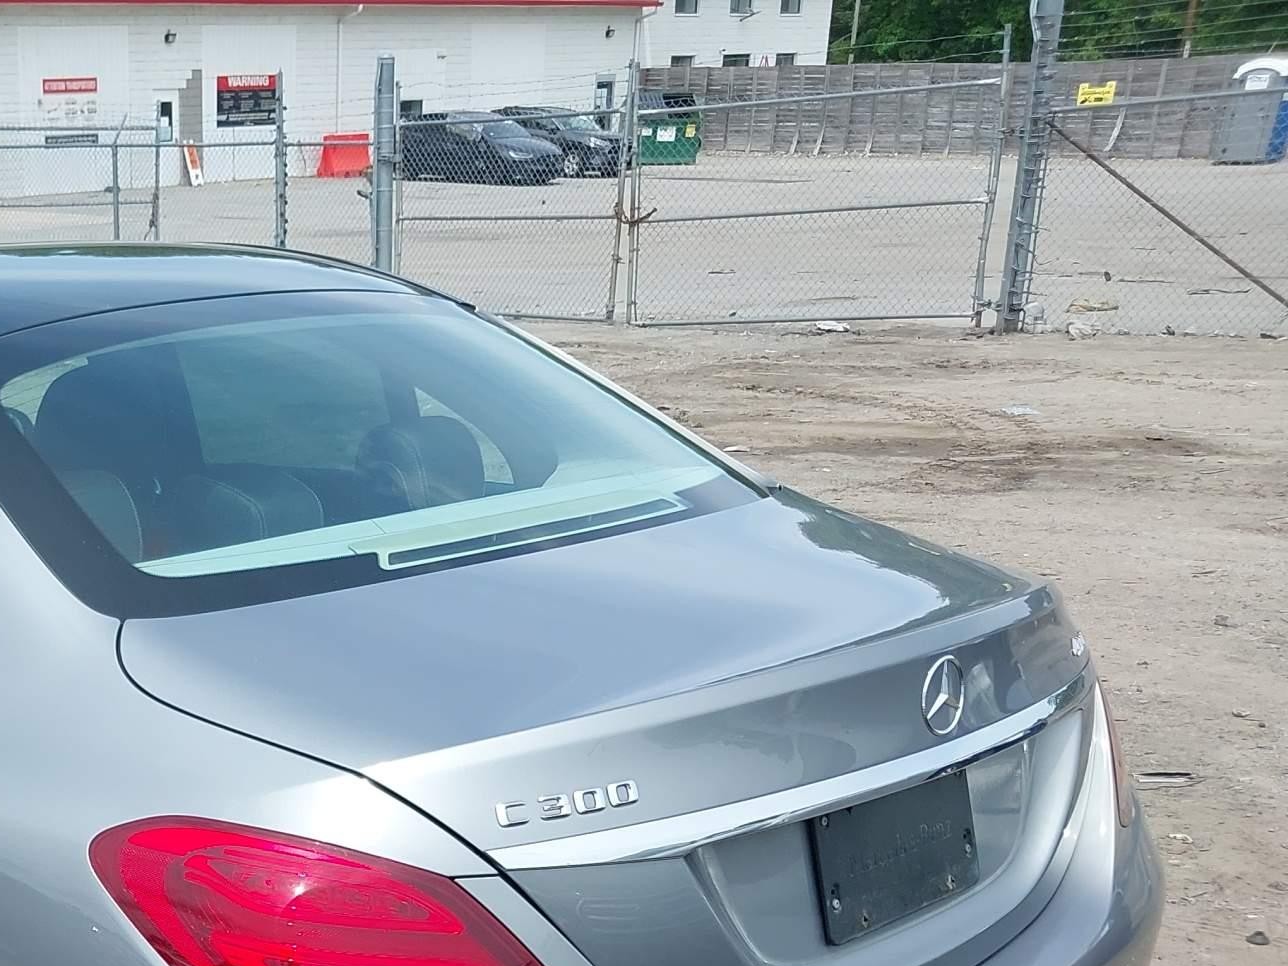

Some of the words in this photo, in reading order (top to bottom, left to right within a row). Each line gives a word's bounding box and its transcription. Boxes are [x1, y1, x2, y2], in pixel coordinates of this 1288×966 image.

[227, 75, 269, 87] WARNING
[495, 801, 530, 828] C
[536, 779, 639, 821] 300
